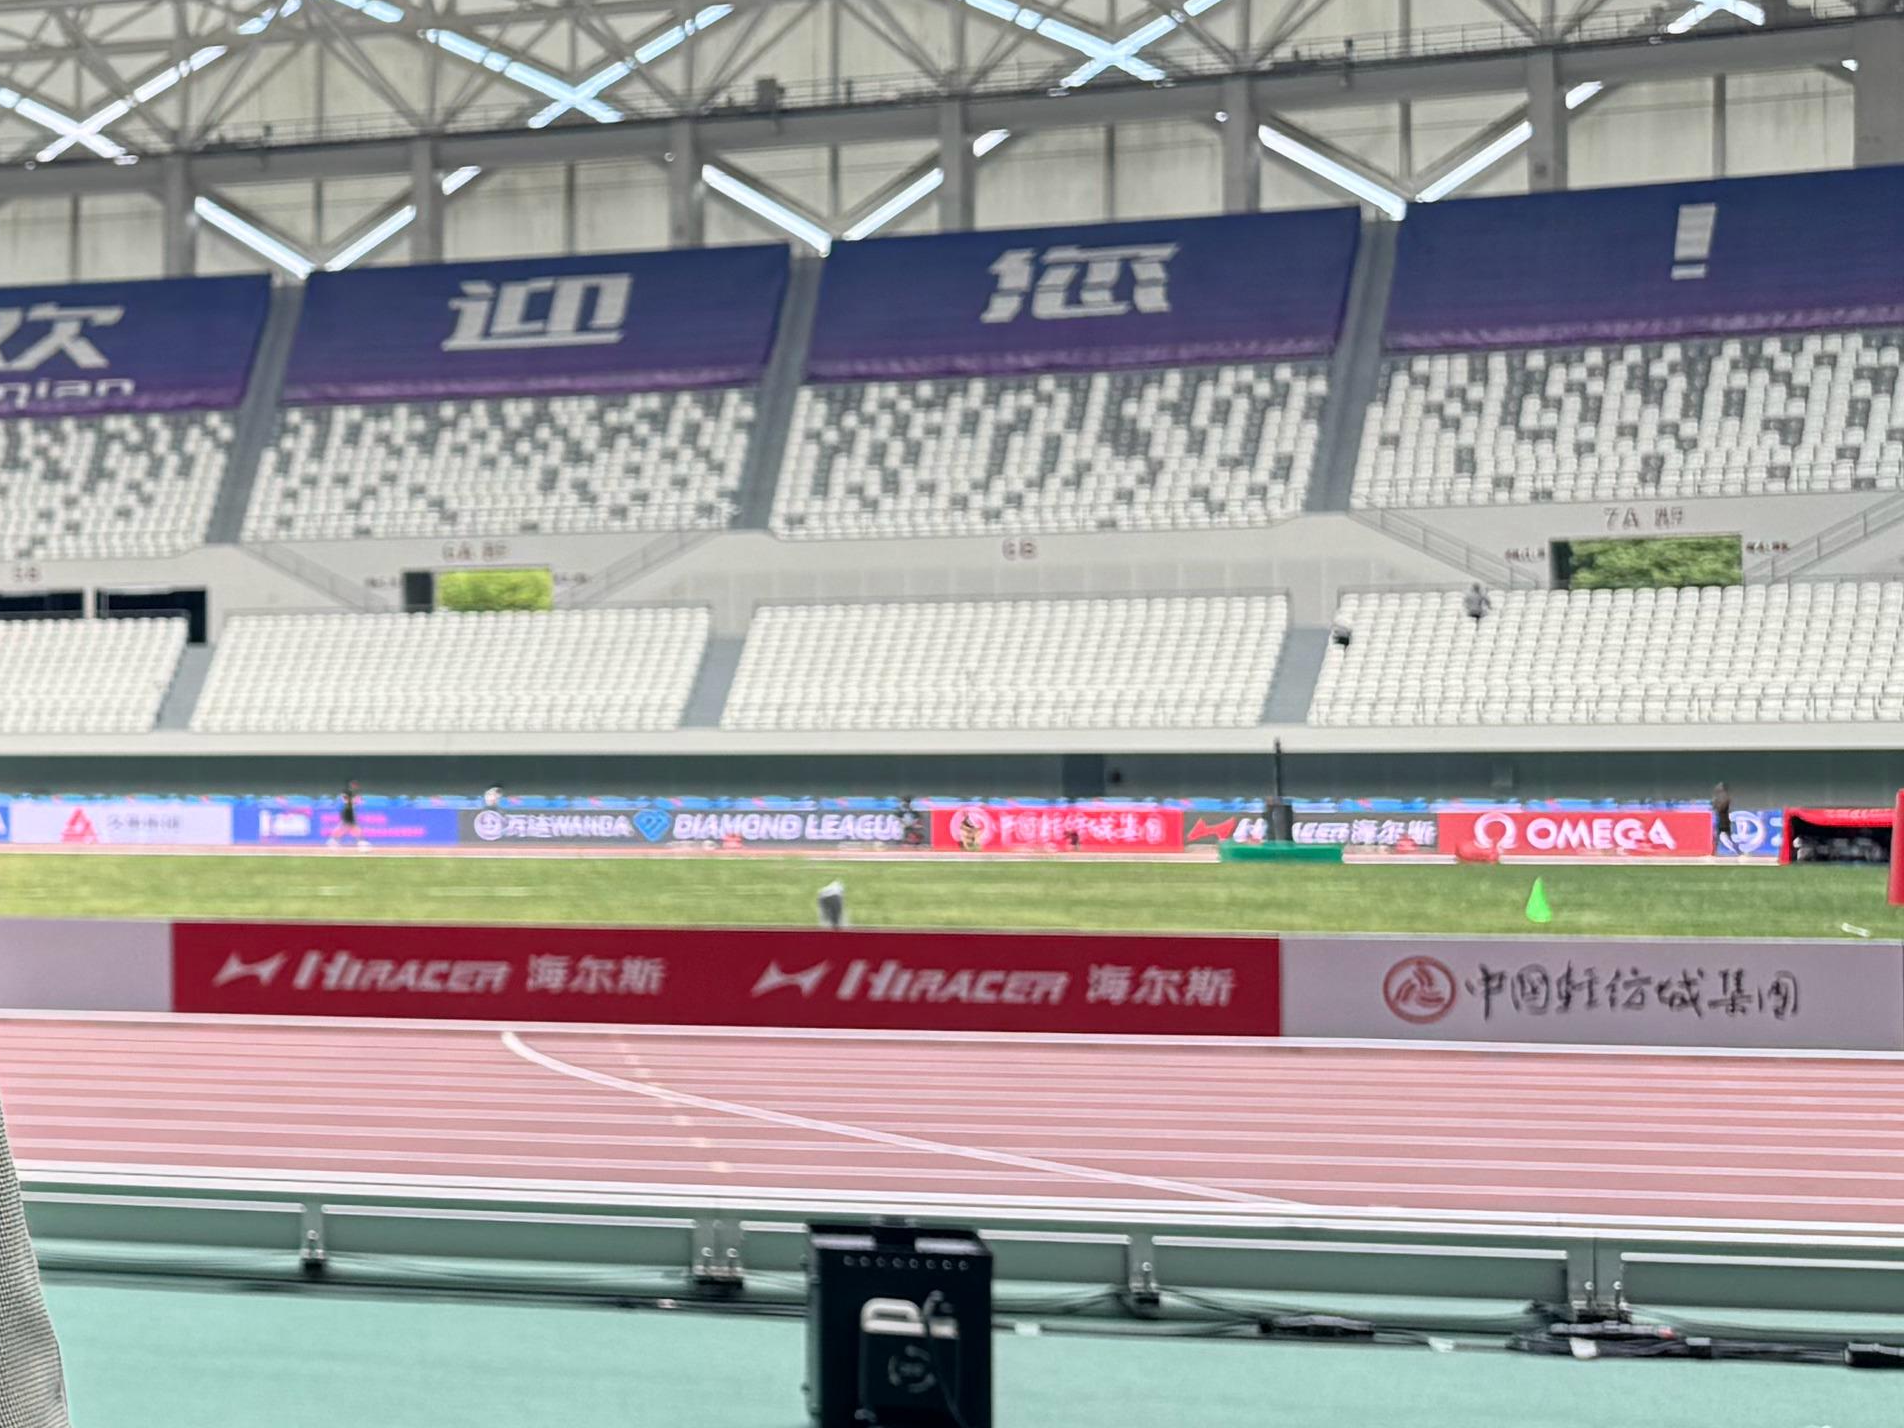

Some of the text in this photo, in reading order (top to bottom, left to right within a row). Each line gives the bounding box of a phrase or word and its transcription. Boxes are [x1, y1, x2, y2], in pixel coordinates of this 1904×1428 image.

[442, 272, 633, 352] 迎
[673, 813, 902, 840] DIAMOND LEAGU
[1526, 817, 1676, 851] OMEGA
[526, 953, 666, 995] 海尔斯
[1085, 963, 1235, 1007] 海尔斯
